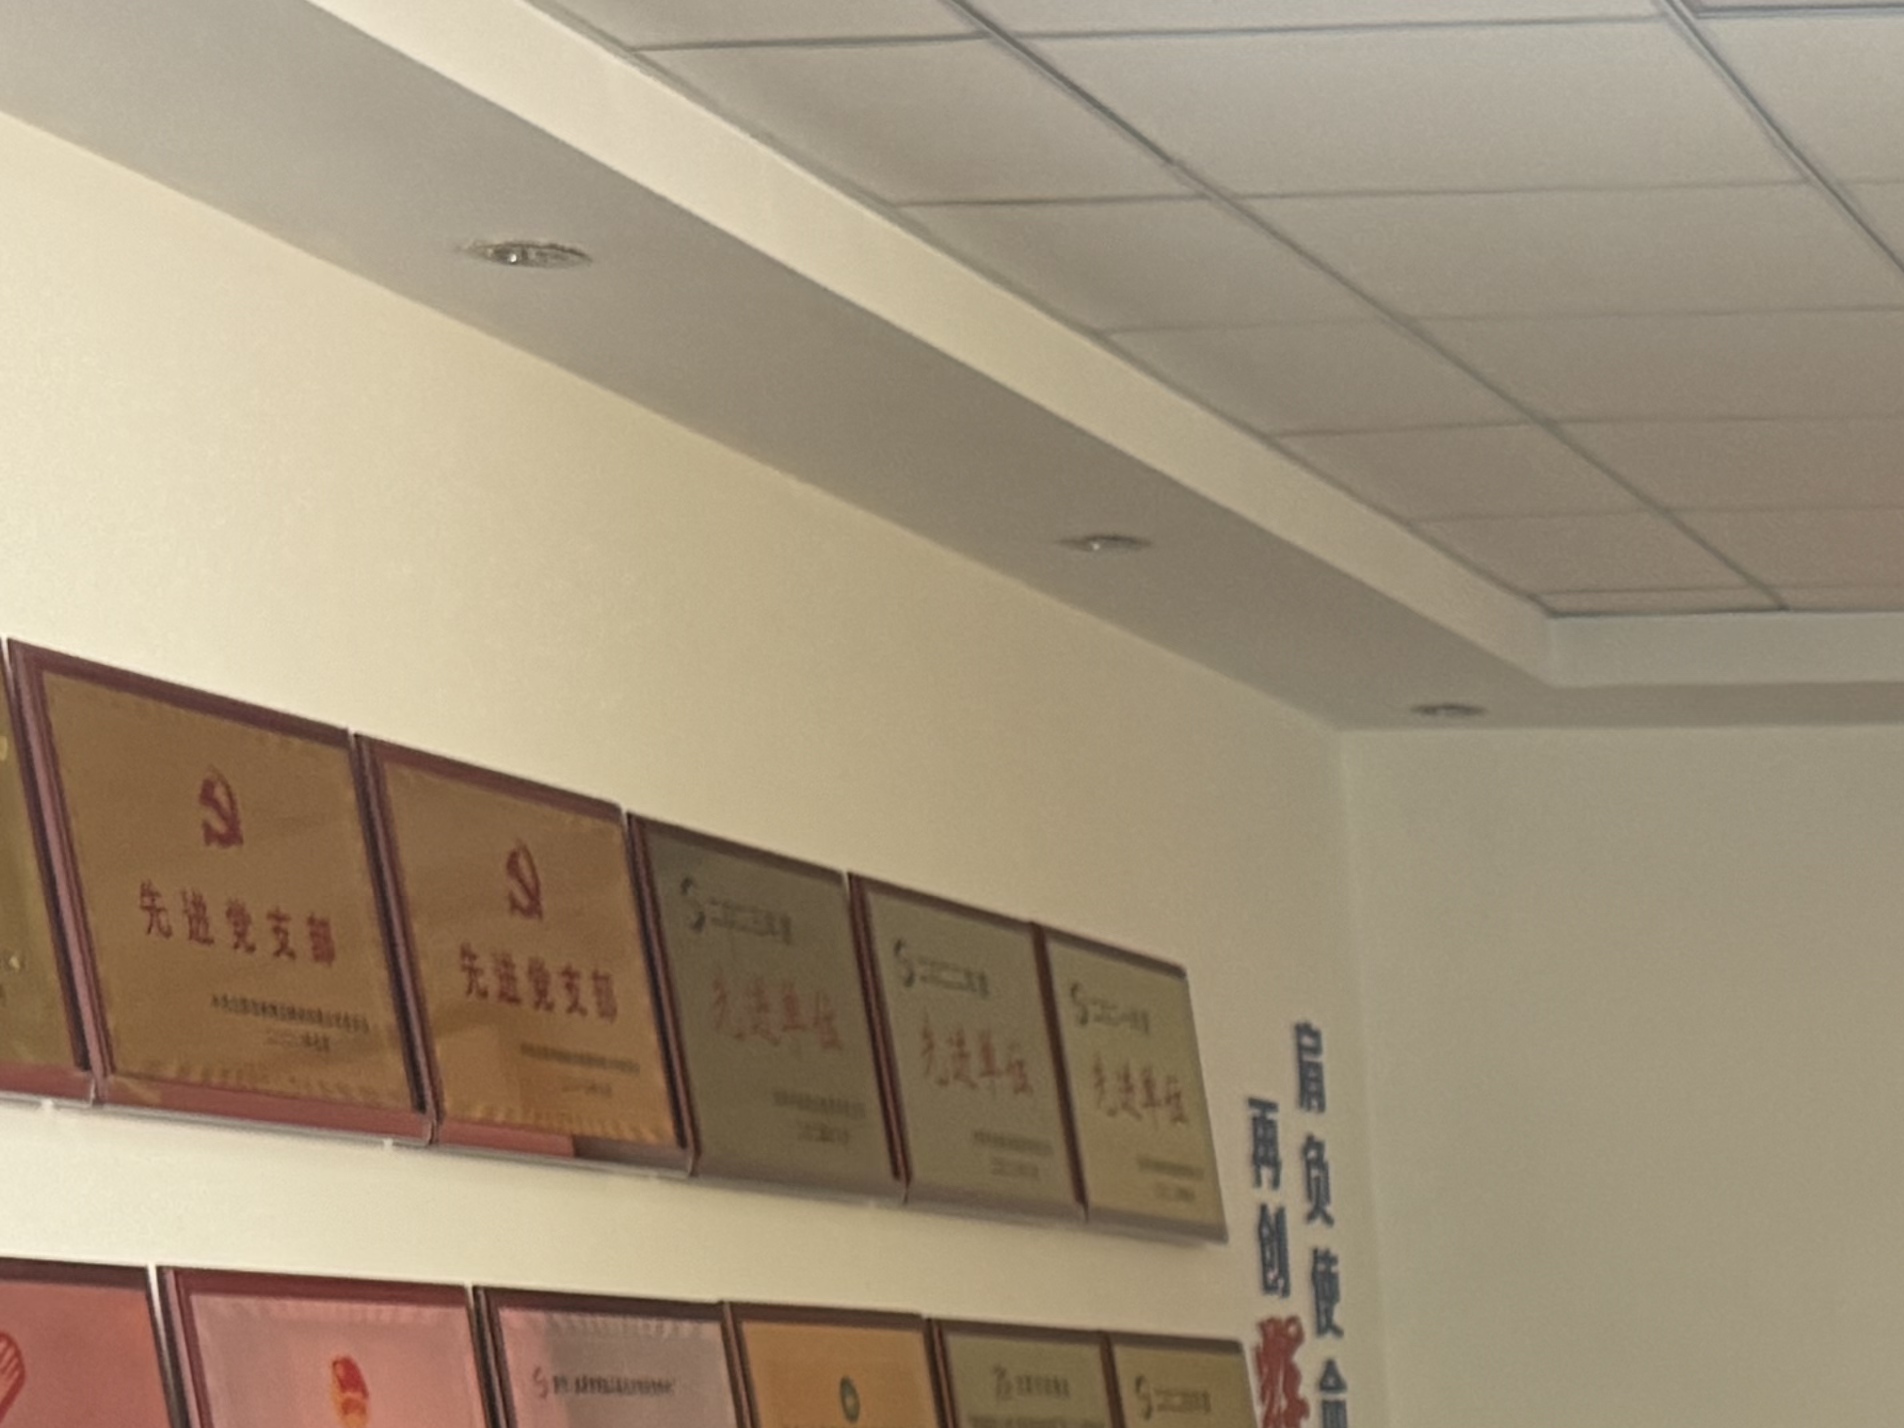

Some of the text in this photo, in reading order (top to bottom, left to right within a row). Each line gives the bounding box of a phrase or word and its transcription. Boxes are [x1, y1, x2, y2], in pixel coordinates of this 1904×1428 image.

[139, 881, 337, 966] 先进党支部
[461, 942, 619, 1020] 先进党支部
